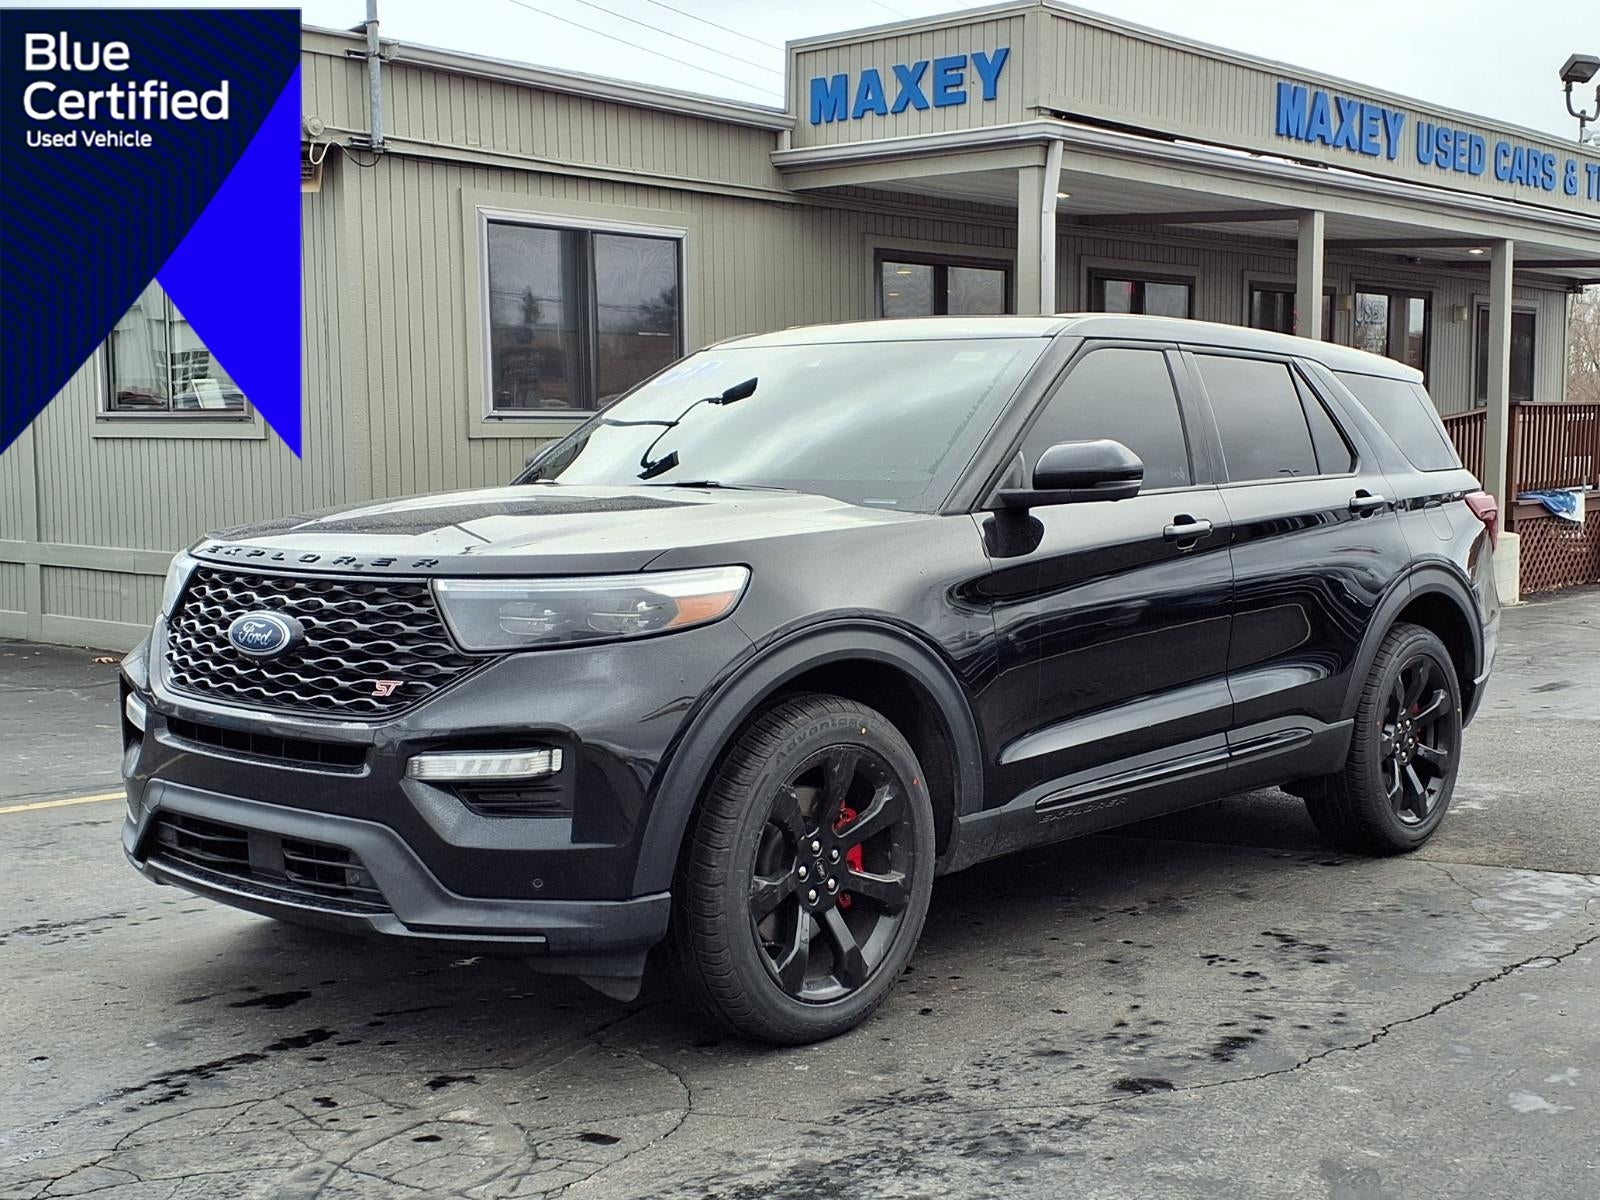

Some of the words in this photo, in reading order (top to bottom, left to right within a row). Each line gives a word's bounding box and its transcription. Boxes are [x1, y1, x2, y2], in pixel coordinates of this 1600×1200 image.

[810, 47, 1011, 125] MAXEY
[1276, 82, 1405, 161] MAXEY
[1416, 120, 1486, 176] USED
[1495, 141, 1556, 191] CARS
[1563, 158, 1578, 196] &
[1585, 162, 1600, 202] T
[207, 545, 440, 569] EXPLORER
[238, 621, 273, 646] Ford
[372, 680, 404, 696] ST
